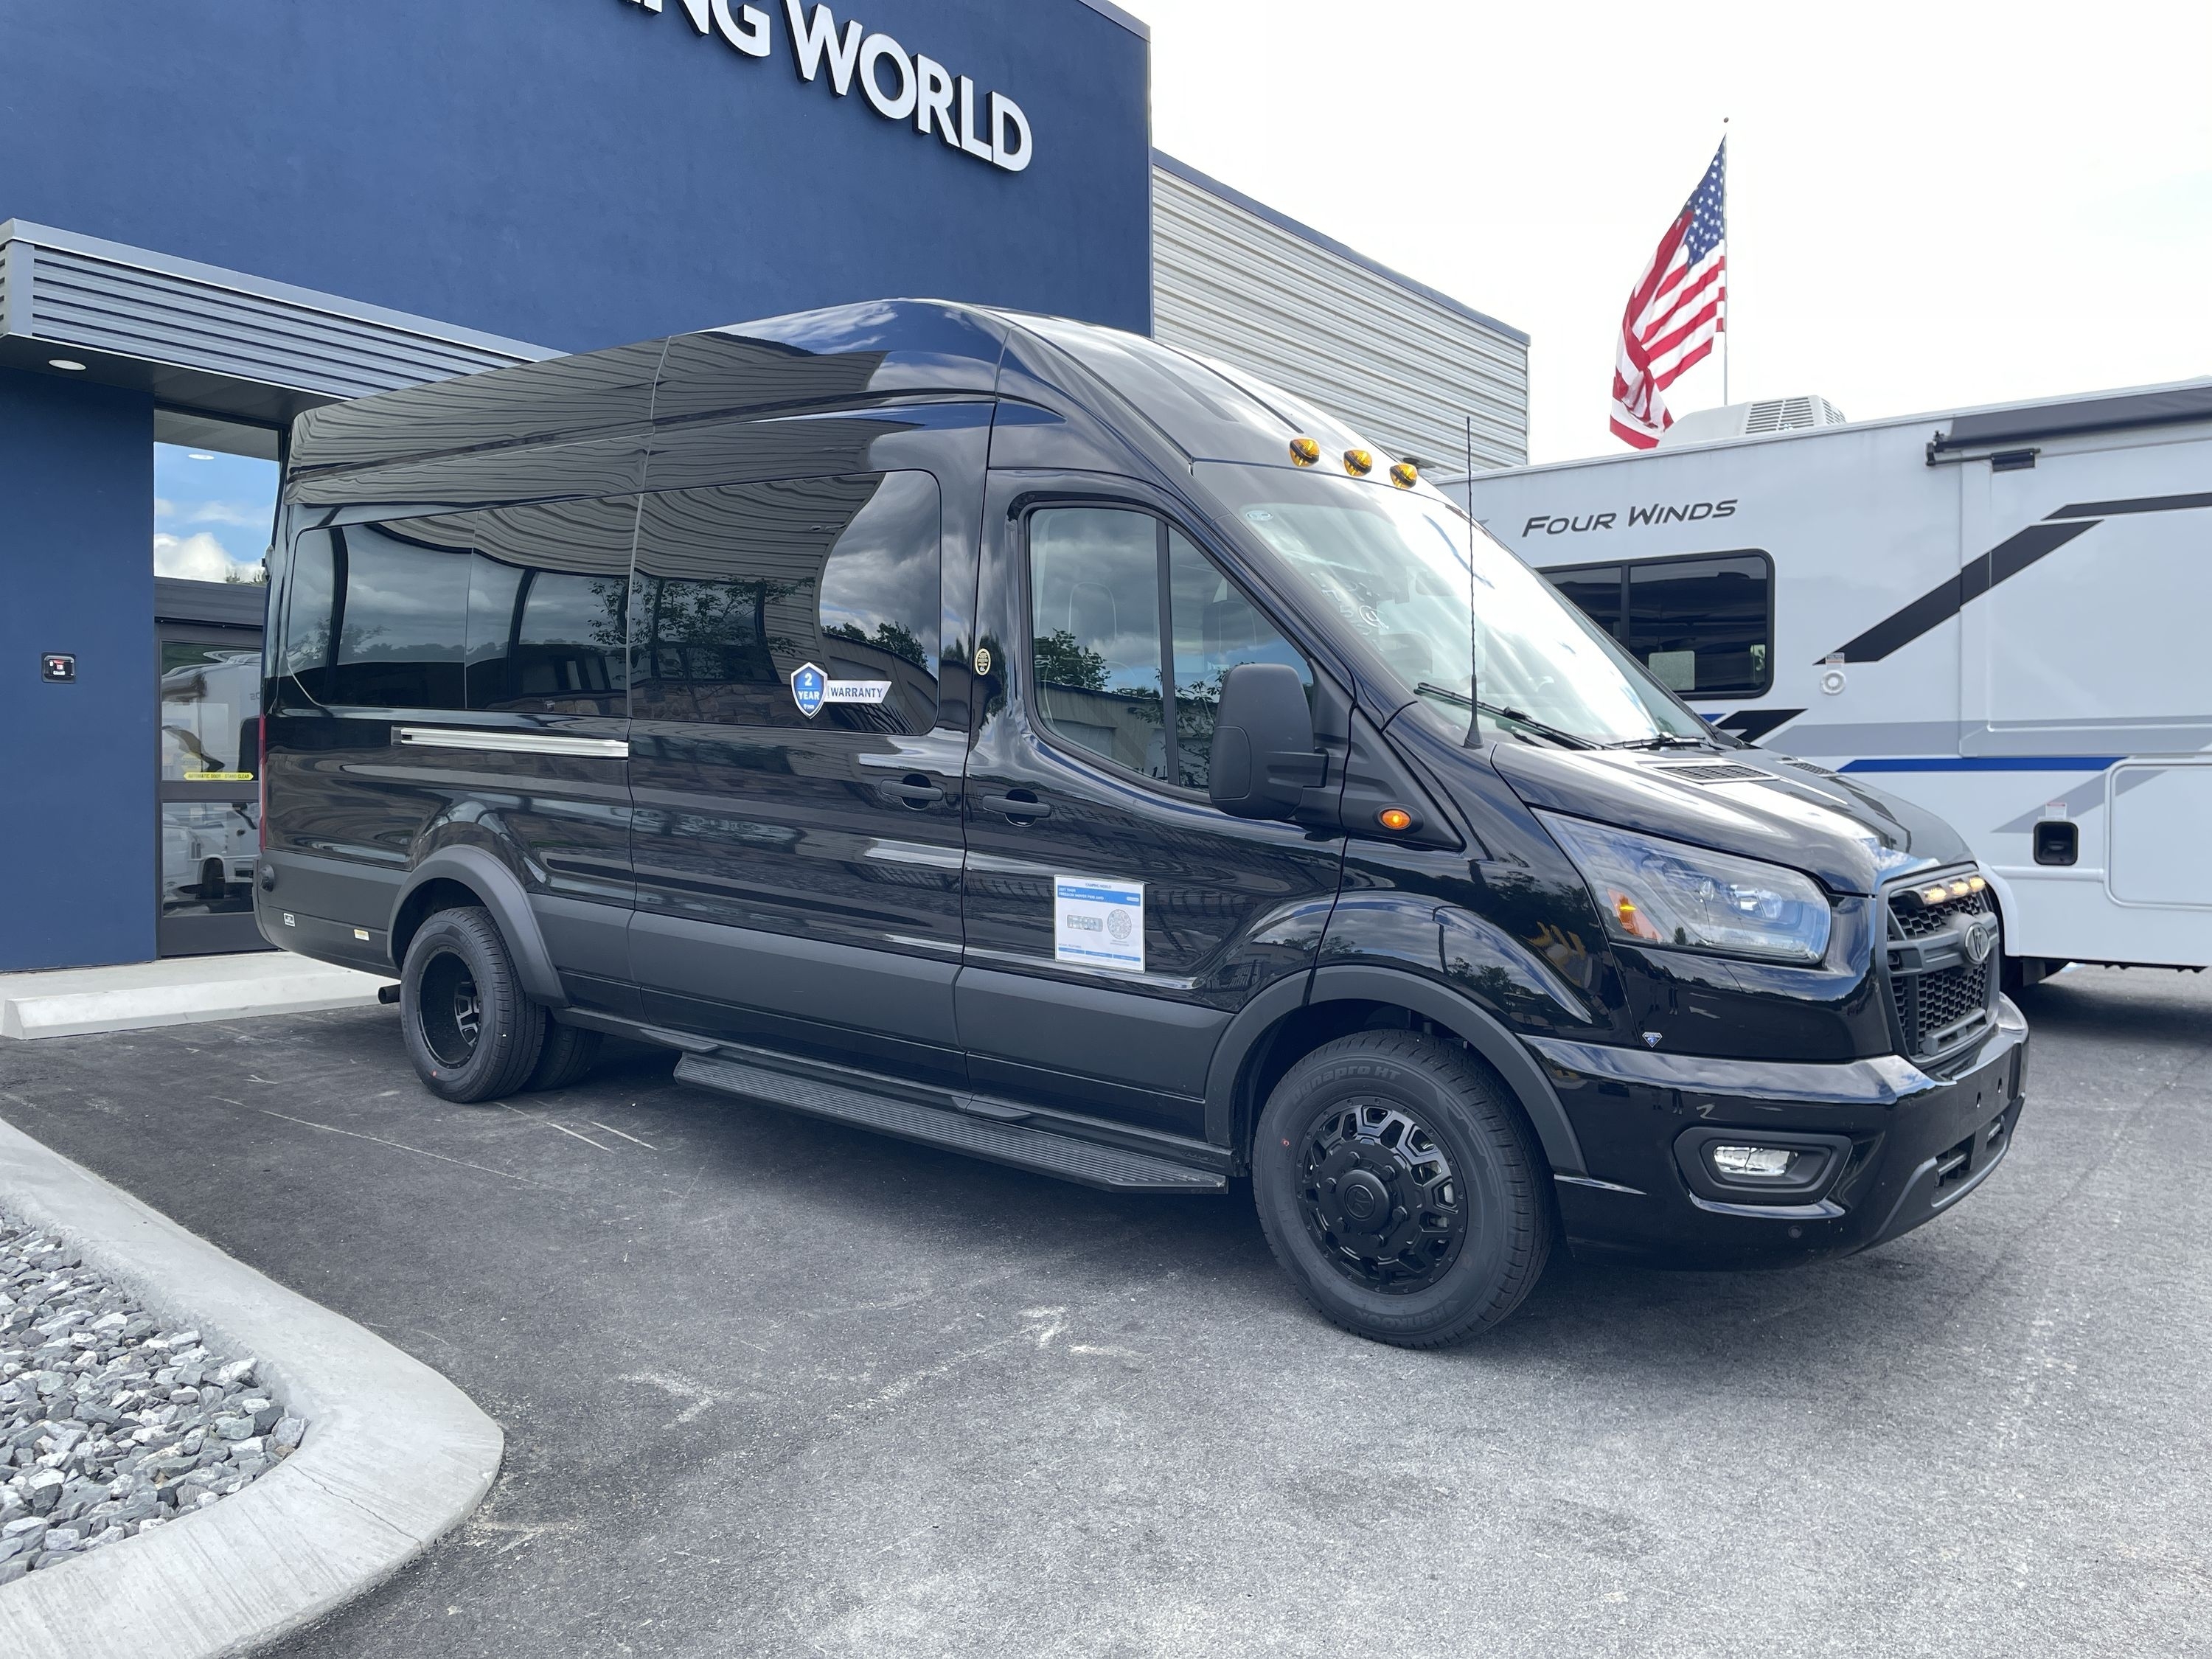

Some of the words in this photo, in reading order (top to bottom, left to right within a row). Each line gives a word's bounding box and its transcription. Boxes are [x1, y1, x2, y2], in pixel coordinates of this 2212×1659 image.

[782, 0, 1033, 173] WORLD
[804, 672, 813, 686] 2
[798, 690, 820, 700] YEAR
[830, 686, 883, 698] WARRANTY
